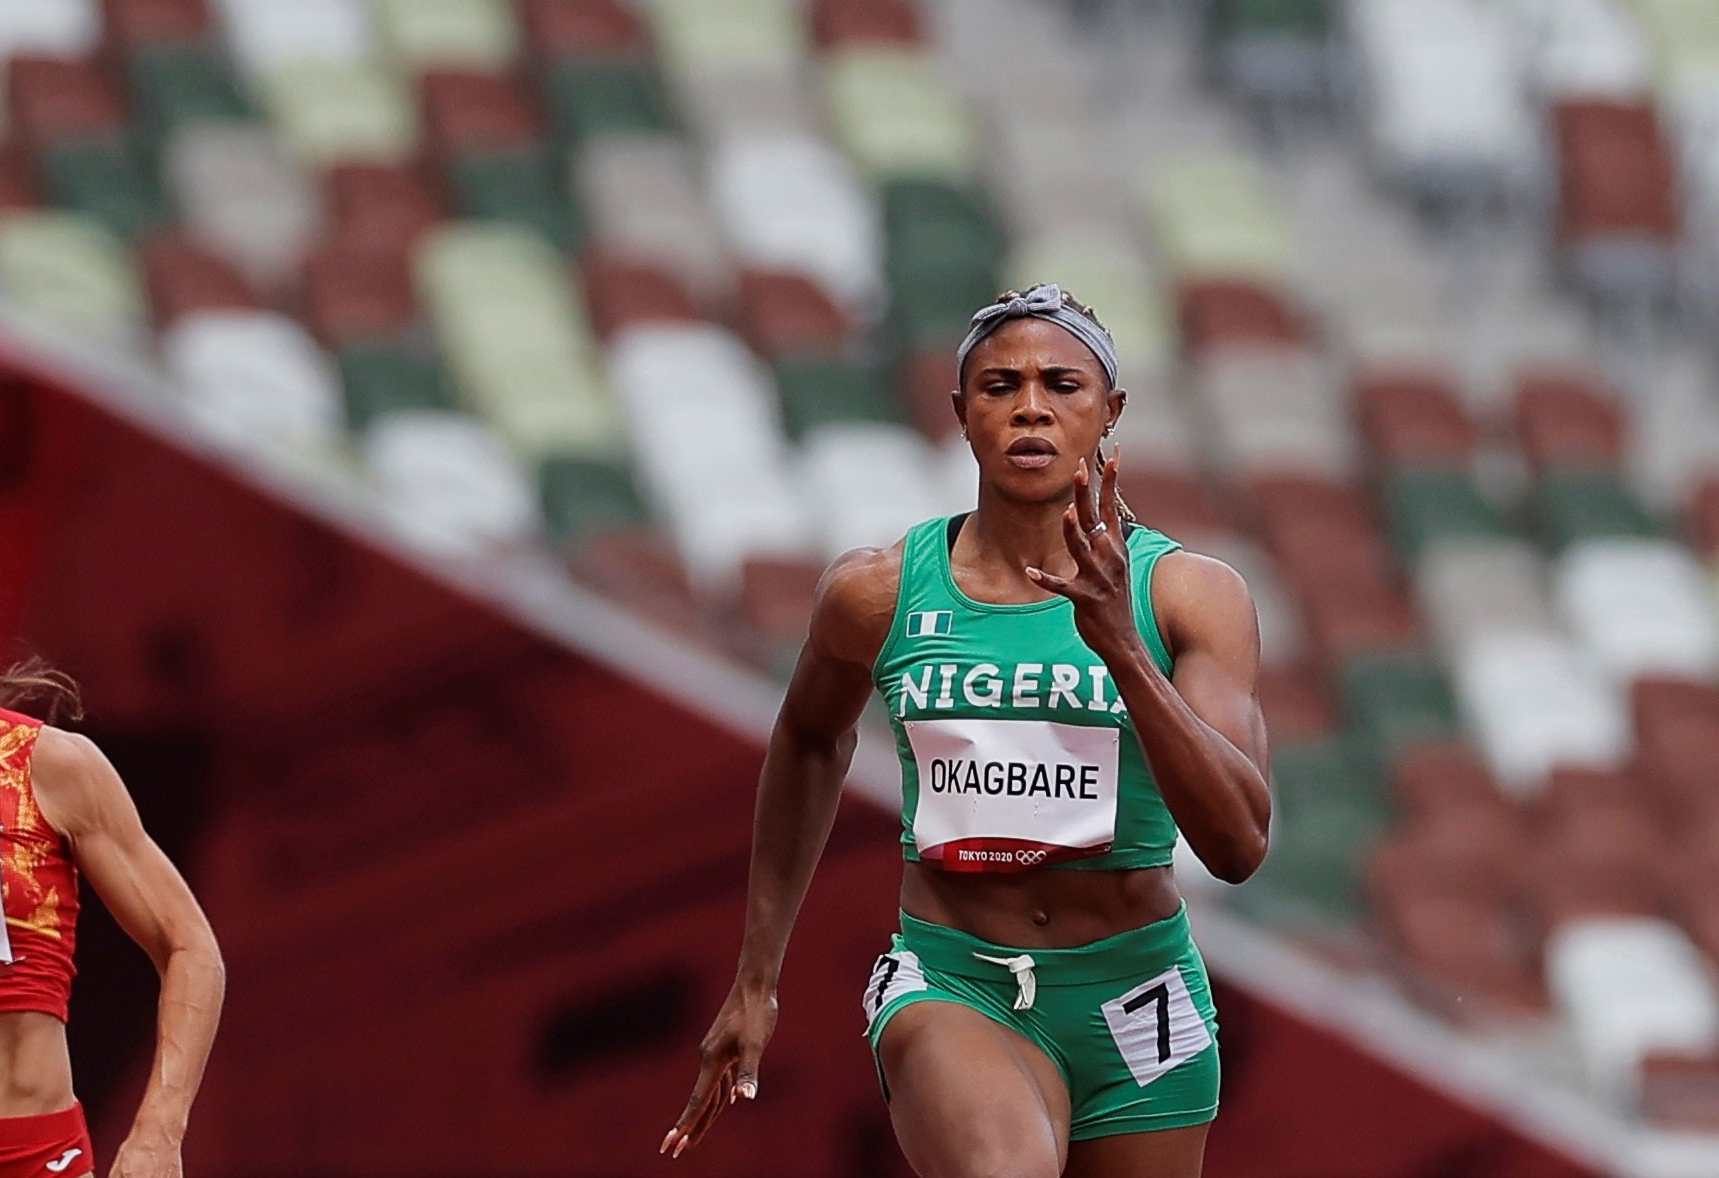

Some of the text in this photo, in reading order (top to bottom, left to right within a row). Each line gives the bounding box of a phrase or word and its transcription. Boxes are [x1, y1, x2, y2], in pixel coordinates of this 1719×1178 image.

[931, 758, 1099, 800] OKAGBARE
[959, 850, 1012, 863] TOKYO 2020
[875, 955, 899, 1013] 7
[1122, 982, 1171, 1065] 7
